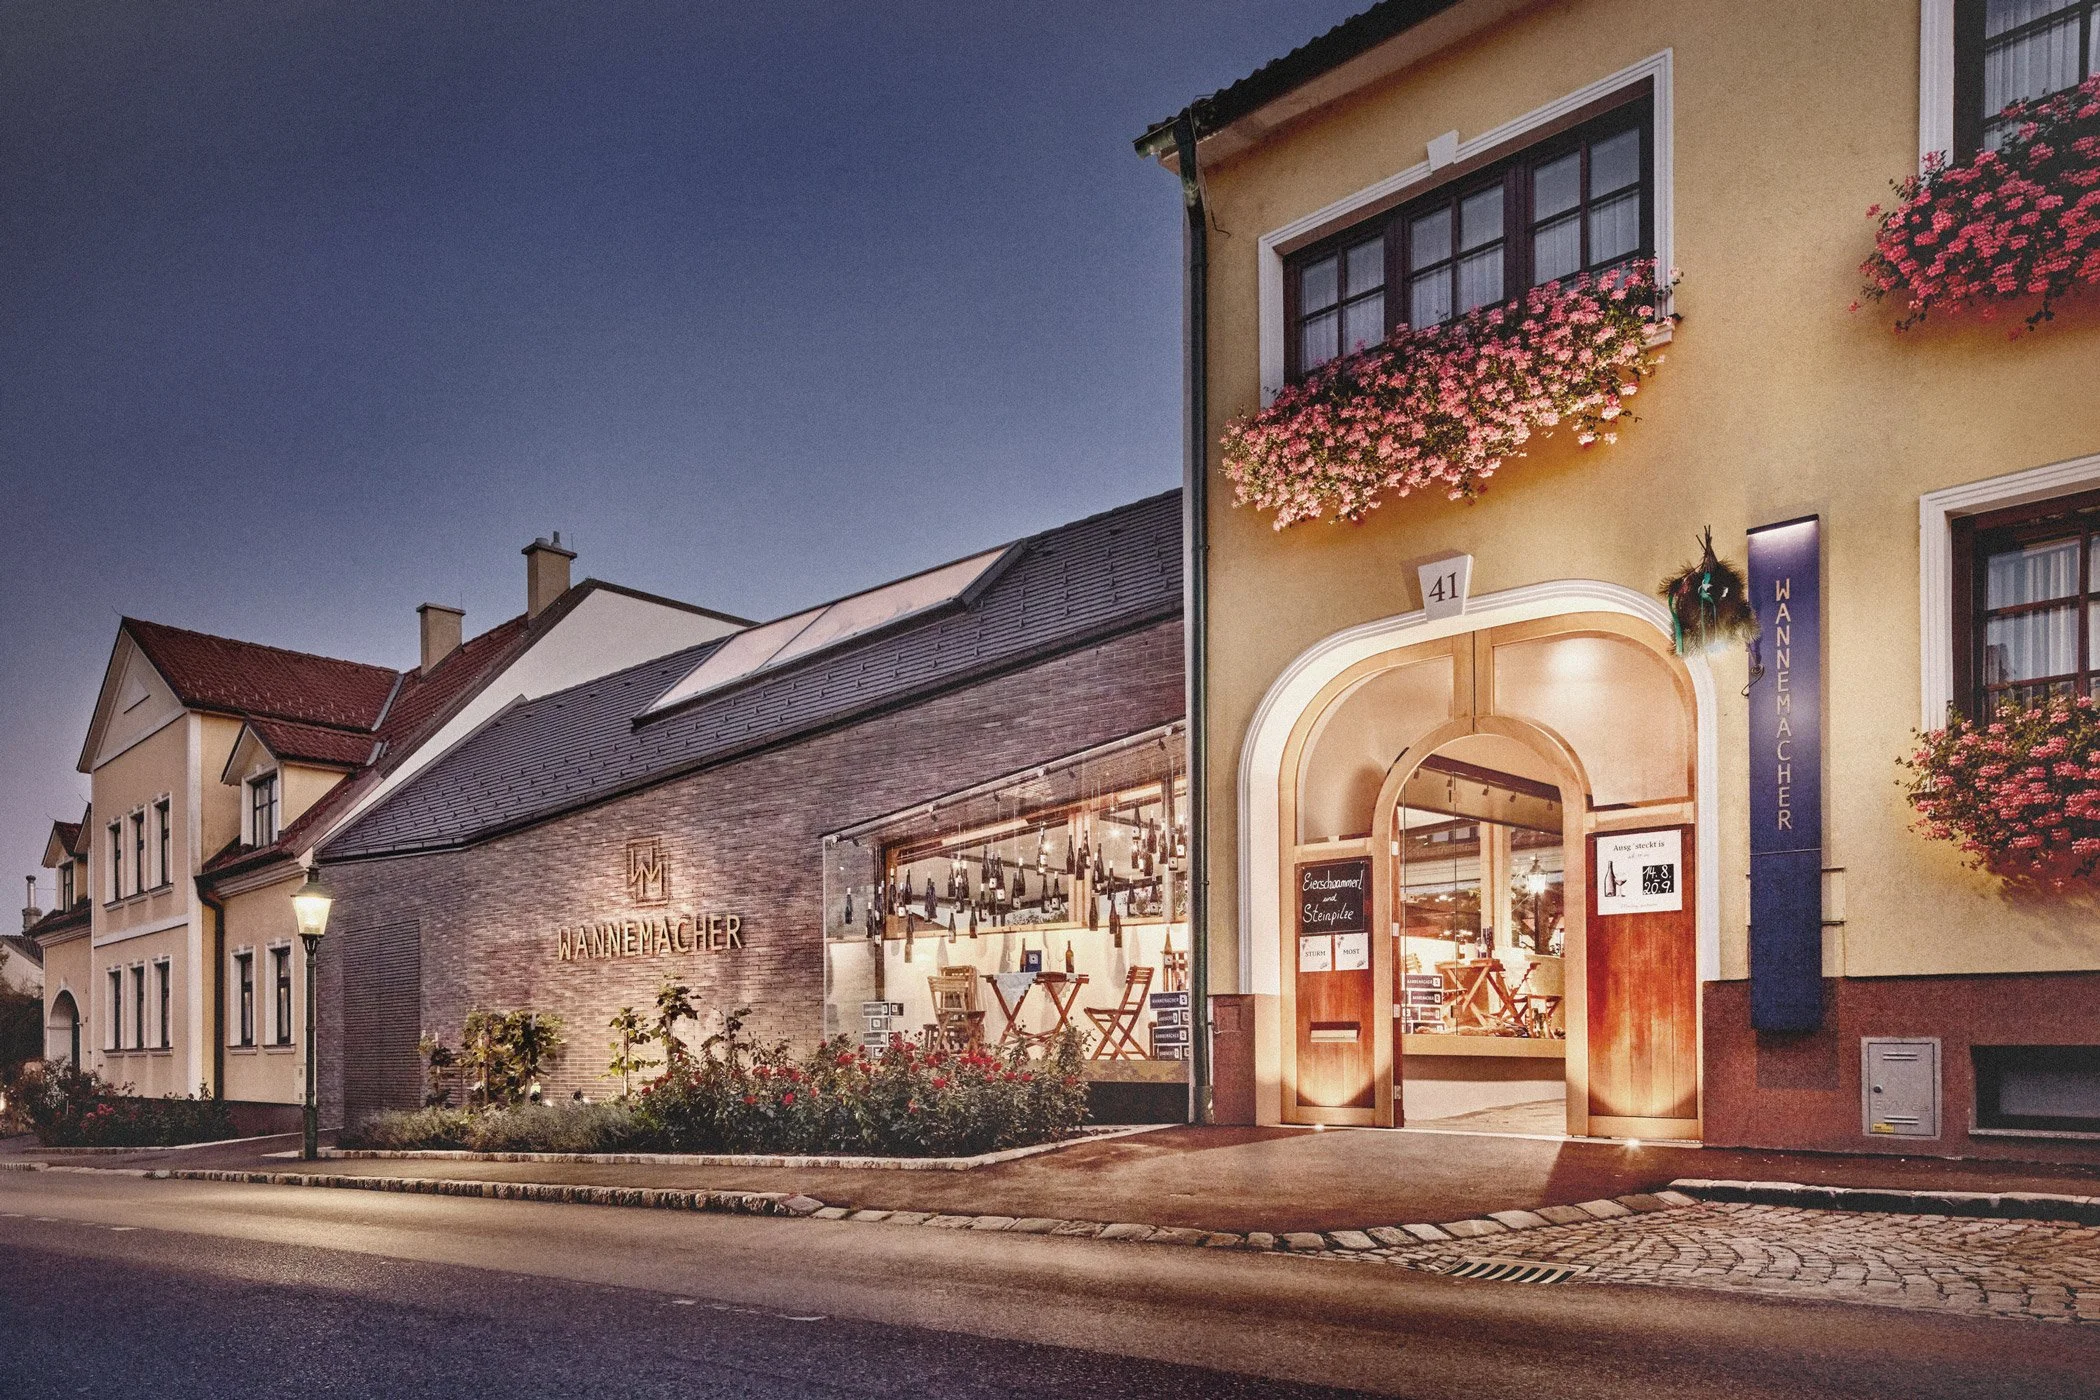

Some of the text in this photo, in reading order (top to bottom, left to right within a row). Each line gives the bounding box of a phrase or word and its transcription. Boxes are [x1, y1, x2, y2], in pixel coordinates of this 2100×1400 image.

[1428, 571, 1459, 603] 41
[1775, 577, 1793, 830] WANNEMACHER
[1661, 864, 1672, 879] 8.
[1322, 892, 1338, 903] und
[1302, 902, 1354, 926] Steinpilze
[557, 914, 743, 962] WANNEMACHER
